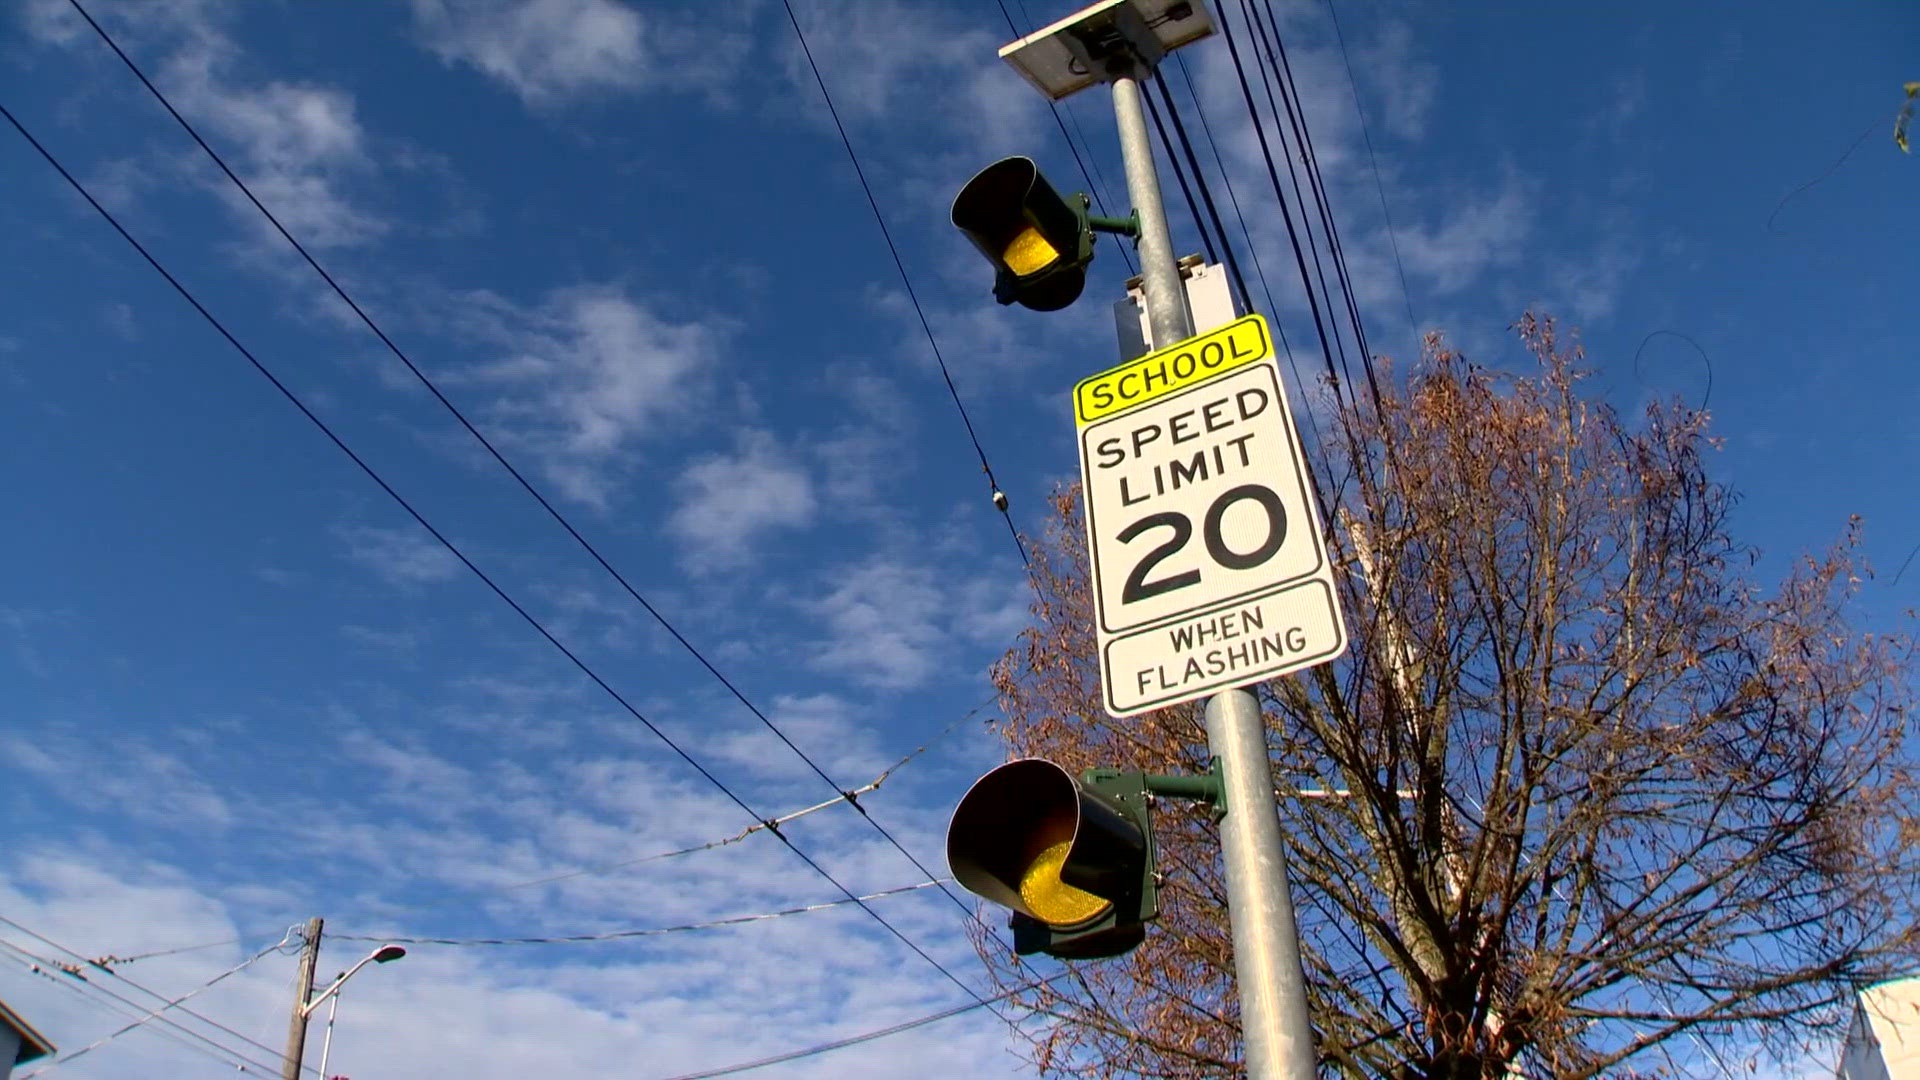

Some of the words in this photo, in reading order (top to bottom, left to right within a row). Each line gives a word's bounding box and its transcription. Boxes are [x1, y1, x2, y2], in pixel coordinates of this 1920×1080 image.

[1092, 334, 1253, 409] SCHOOL
[1097, 388, 1269, 469] SPEED
[1120, 433, 1255, 506] LIMIT
[1115, 484, 1287, 605] 20
[1137, 627, 1306, 695] FLASHING
[1170, 606, 1264, 653] WHEN
